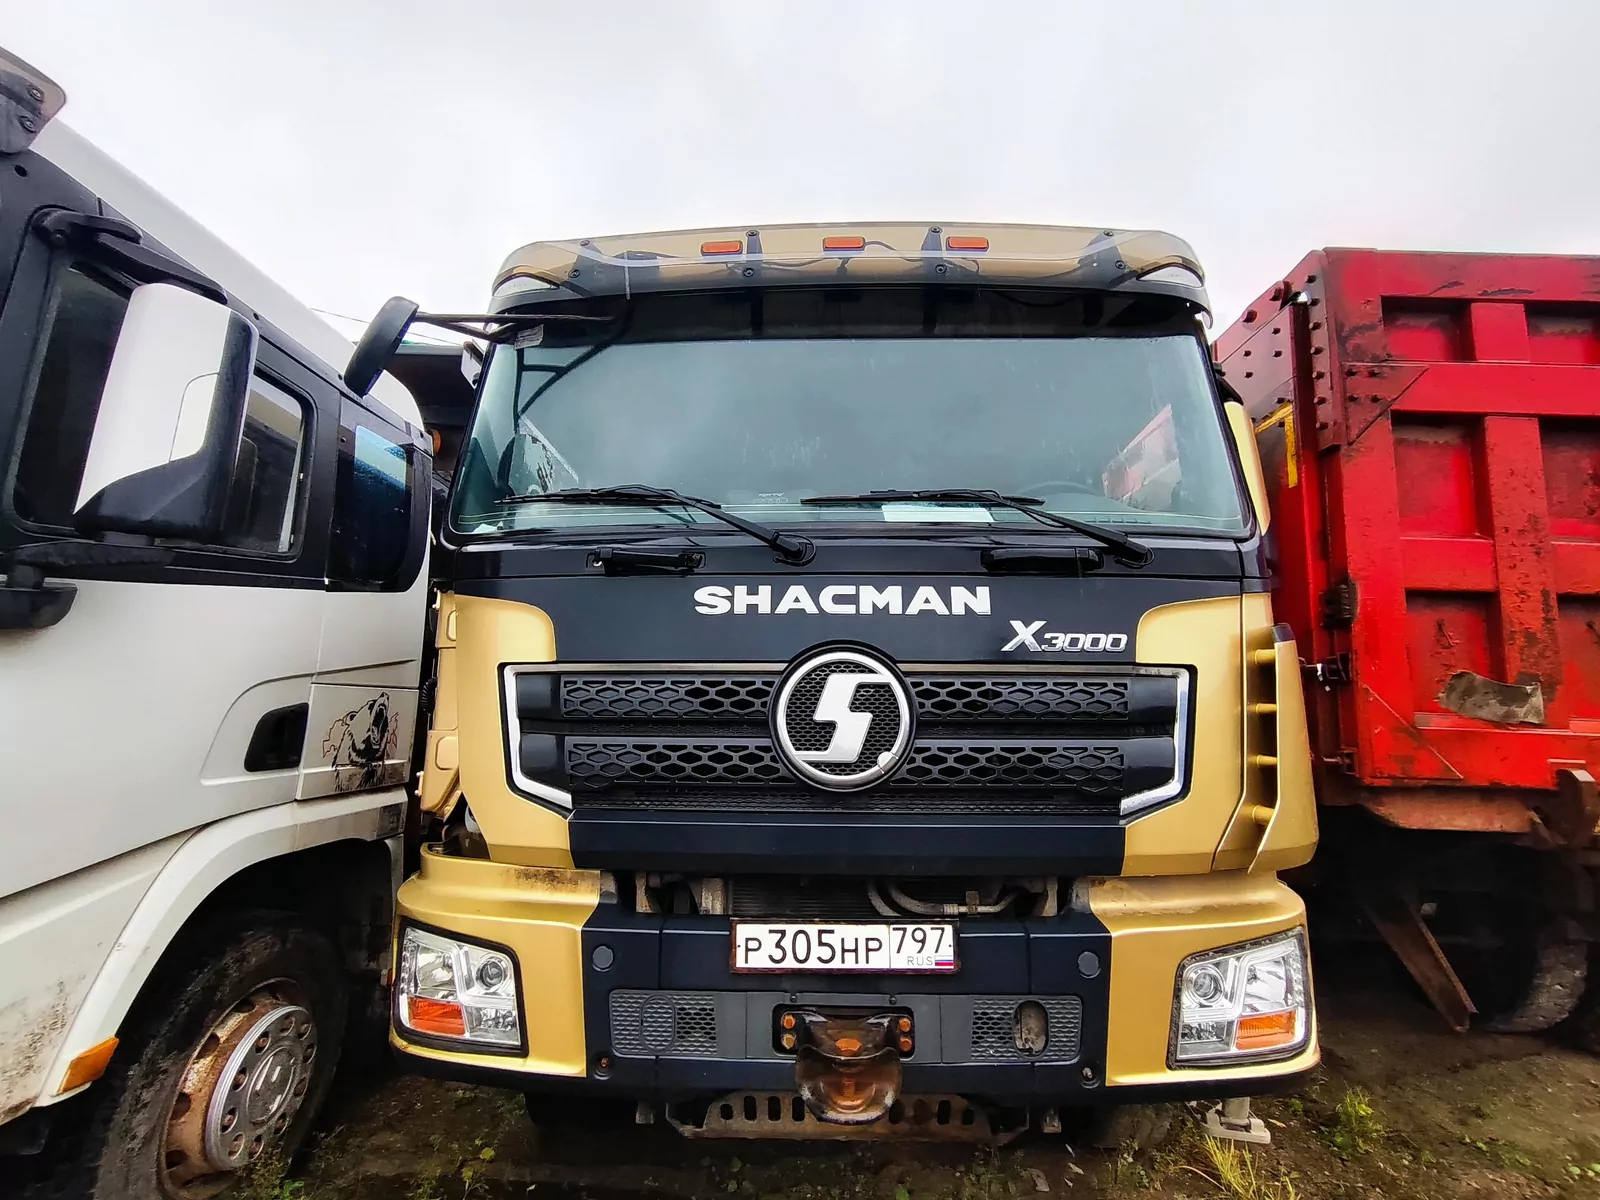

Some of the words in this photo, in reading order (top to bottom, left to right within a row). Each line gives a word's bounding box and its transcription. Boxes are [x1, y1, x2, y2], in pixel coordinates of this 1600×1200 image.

[693, 585, 992, 616] SHACMAN
[1001, 620, 1128, 653] X3000
[892, 926, 946, 954] 797
[907, 955, 934, 966] RUS
